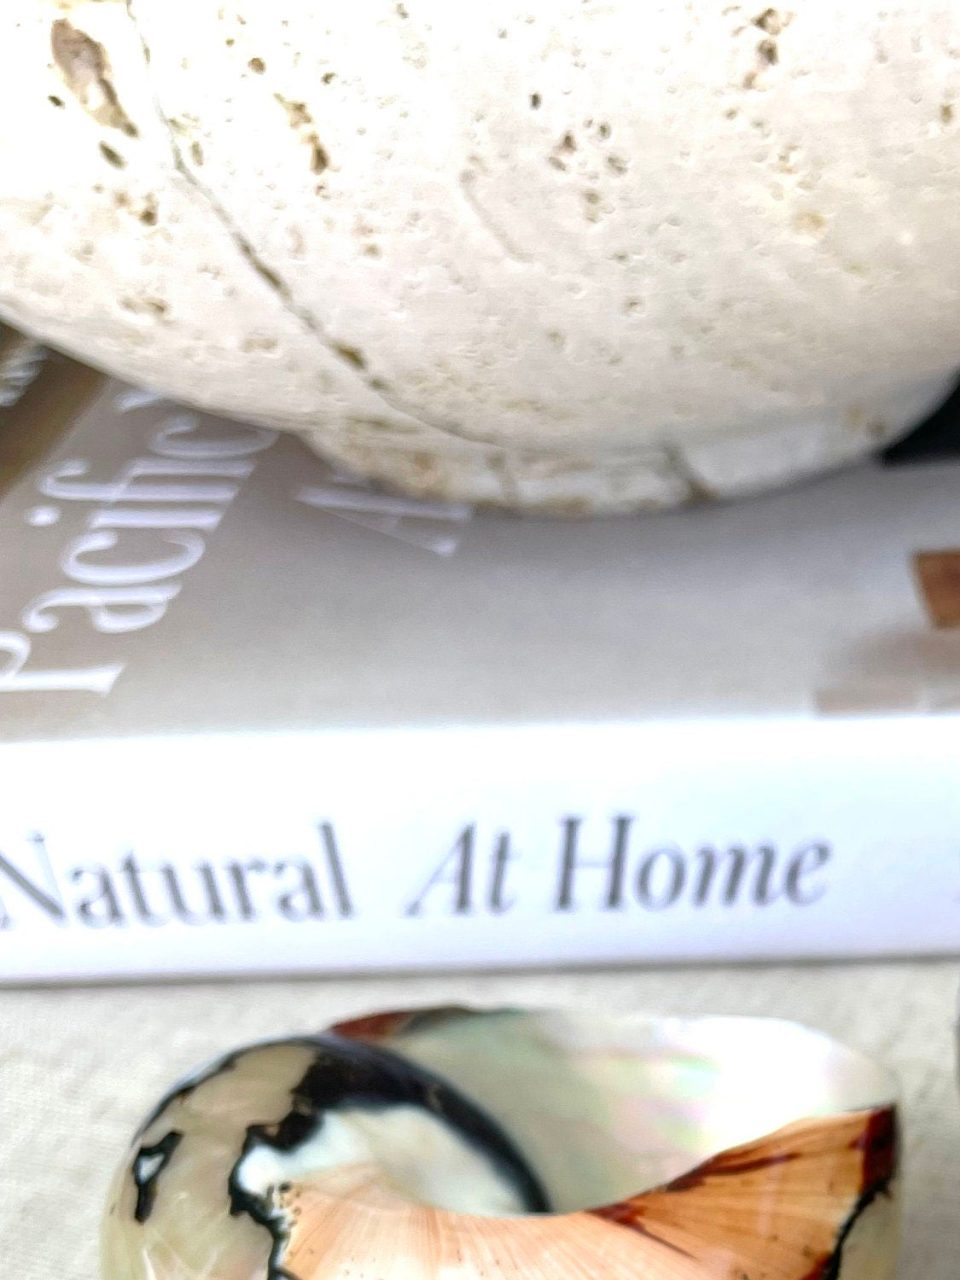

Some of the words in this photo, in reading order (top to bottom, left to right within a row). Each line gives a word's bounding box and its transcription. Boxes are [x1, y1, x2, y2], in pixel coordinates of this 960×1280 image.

[0, 415, 283, 697] Pacific
[0, 820, 354, 928] Natural
[404, 820, 518, 916] At
[553, 812, 833, 914] Home
